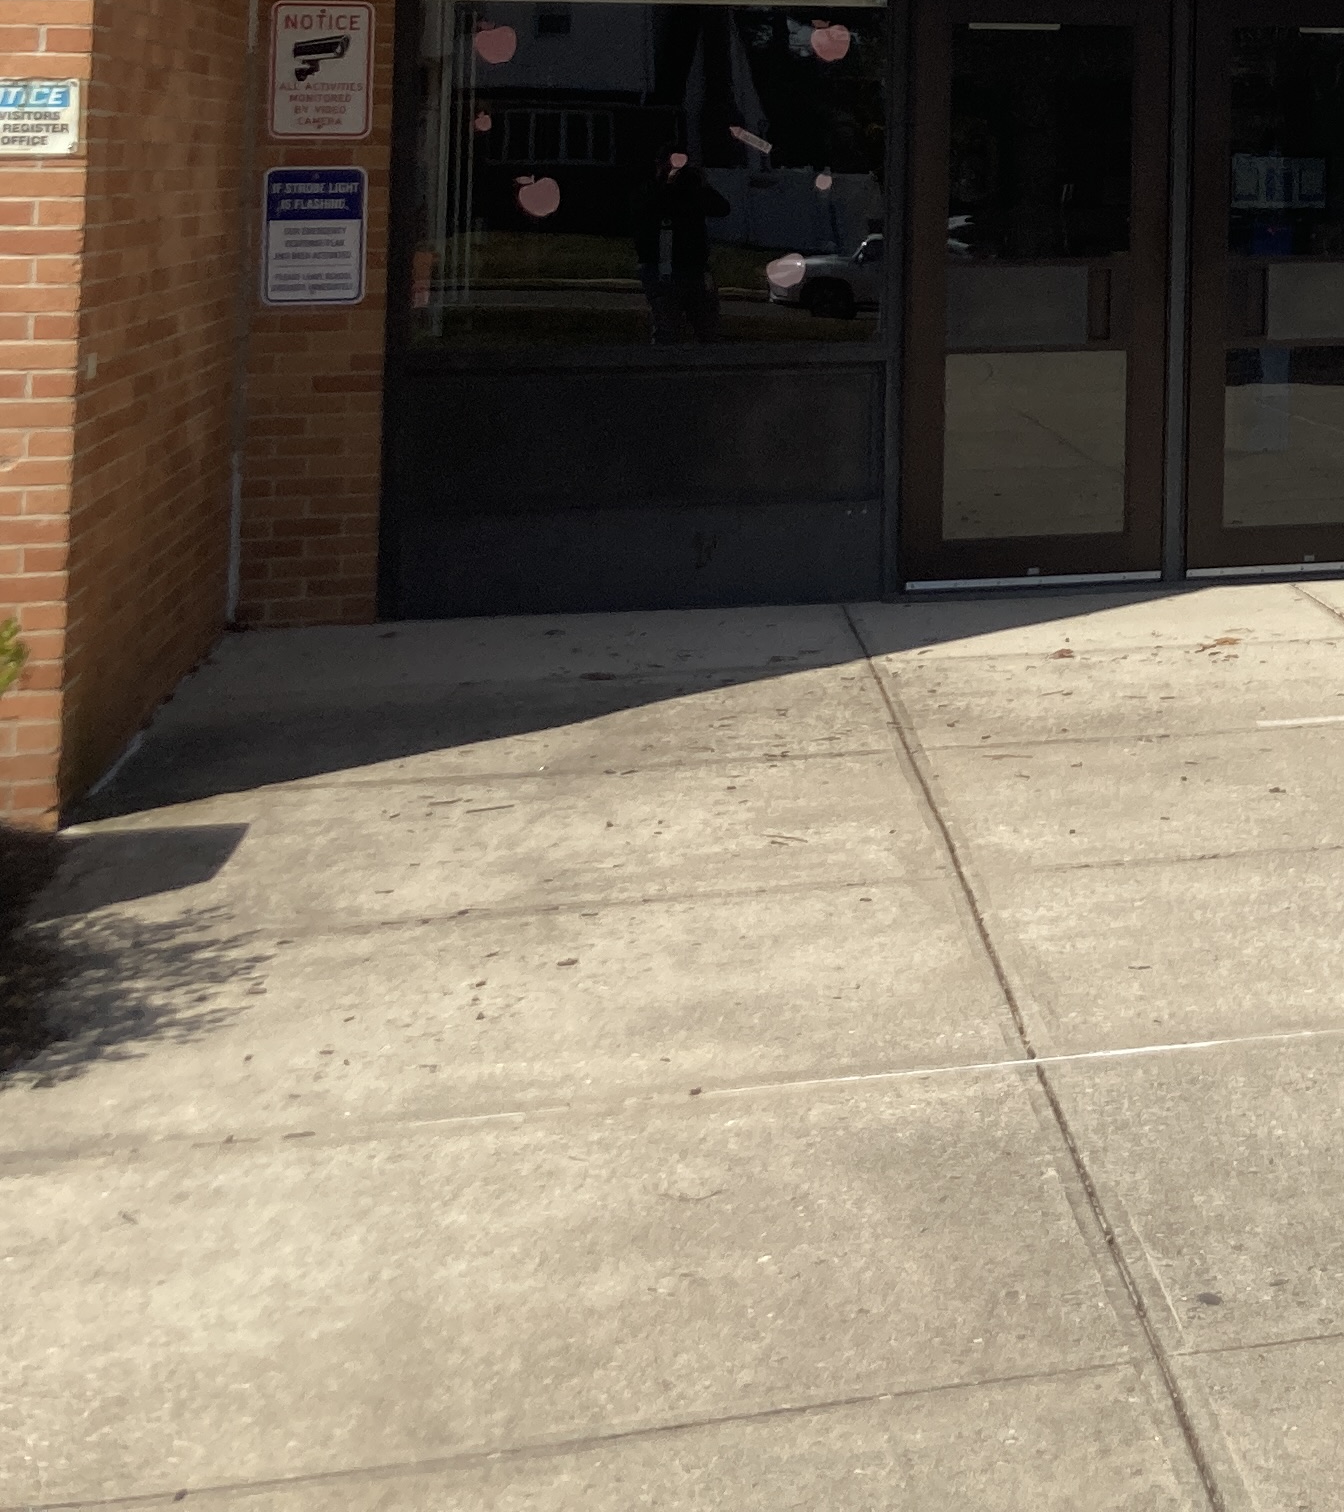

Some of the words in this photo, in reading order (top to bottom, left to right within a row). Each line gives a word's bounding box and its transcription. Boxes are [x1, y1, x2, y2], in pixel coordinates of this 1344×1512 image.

[284, 14, 361, 31] NOTICE
[279, 82, 299, 91] ALL
[305, 82, 364, 92] ACTIVITIES
[0, 87, 67, 105] TICE
[289, 94, 352, 103] MONITORED
[294, 105, 309, 114] BY
[315, 106, 347, 114] VIDEO
[298, 116, 342, 125] CAMERA
[3, 123, 70, 134] REGISTER
[1, 135, 49, 146] OFFICE
[285, 182, 326, 194] STROBE
[328, 182, 360, 194] LIGHT
